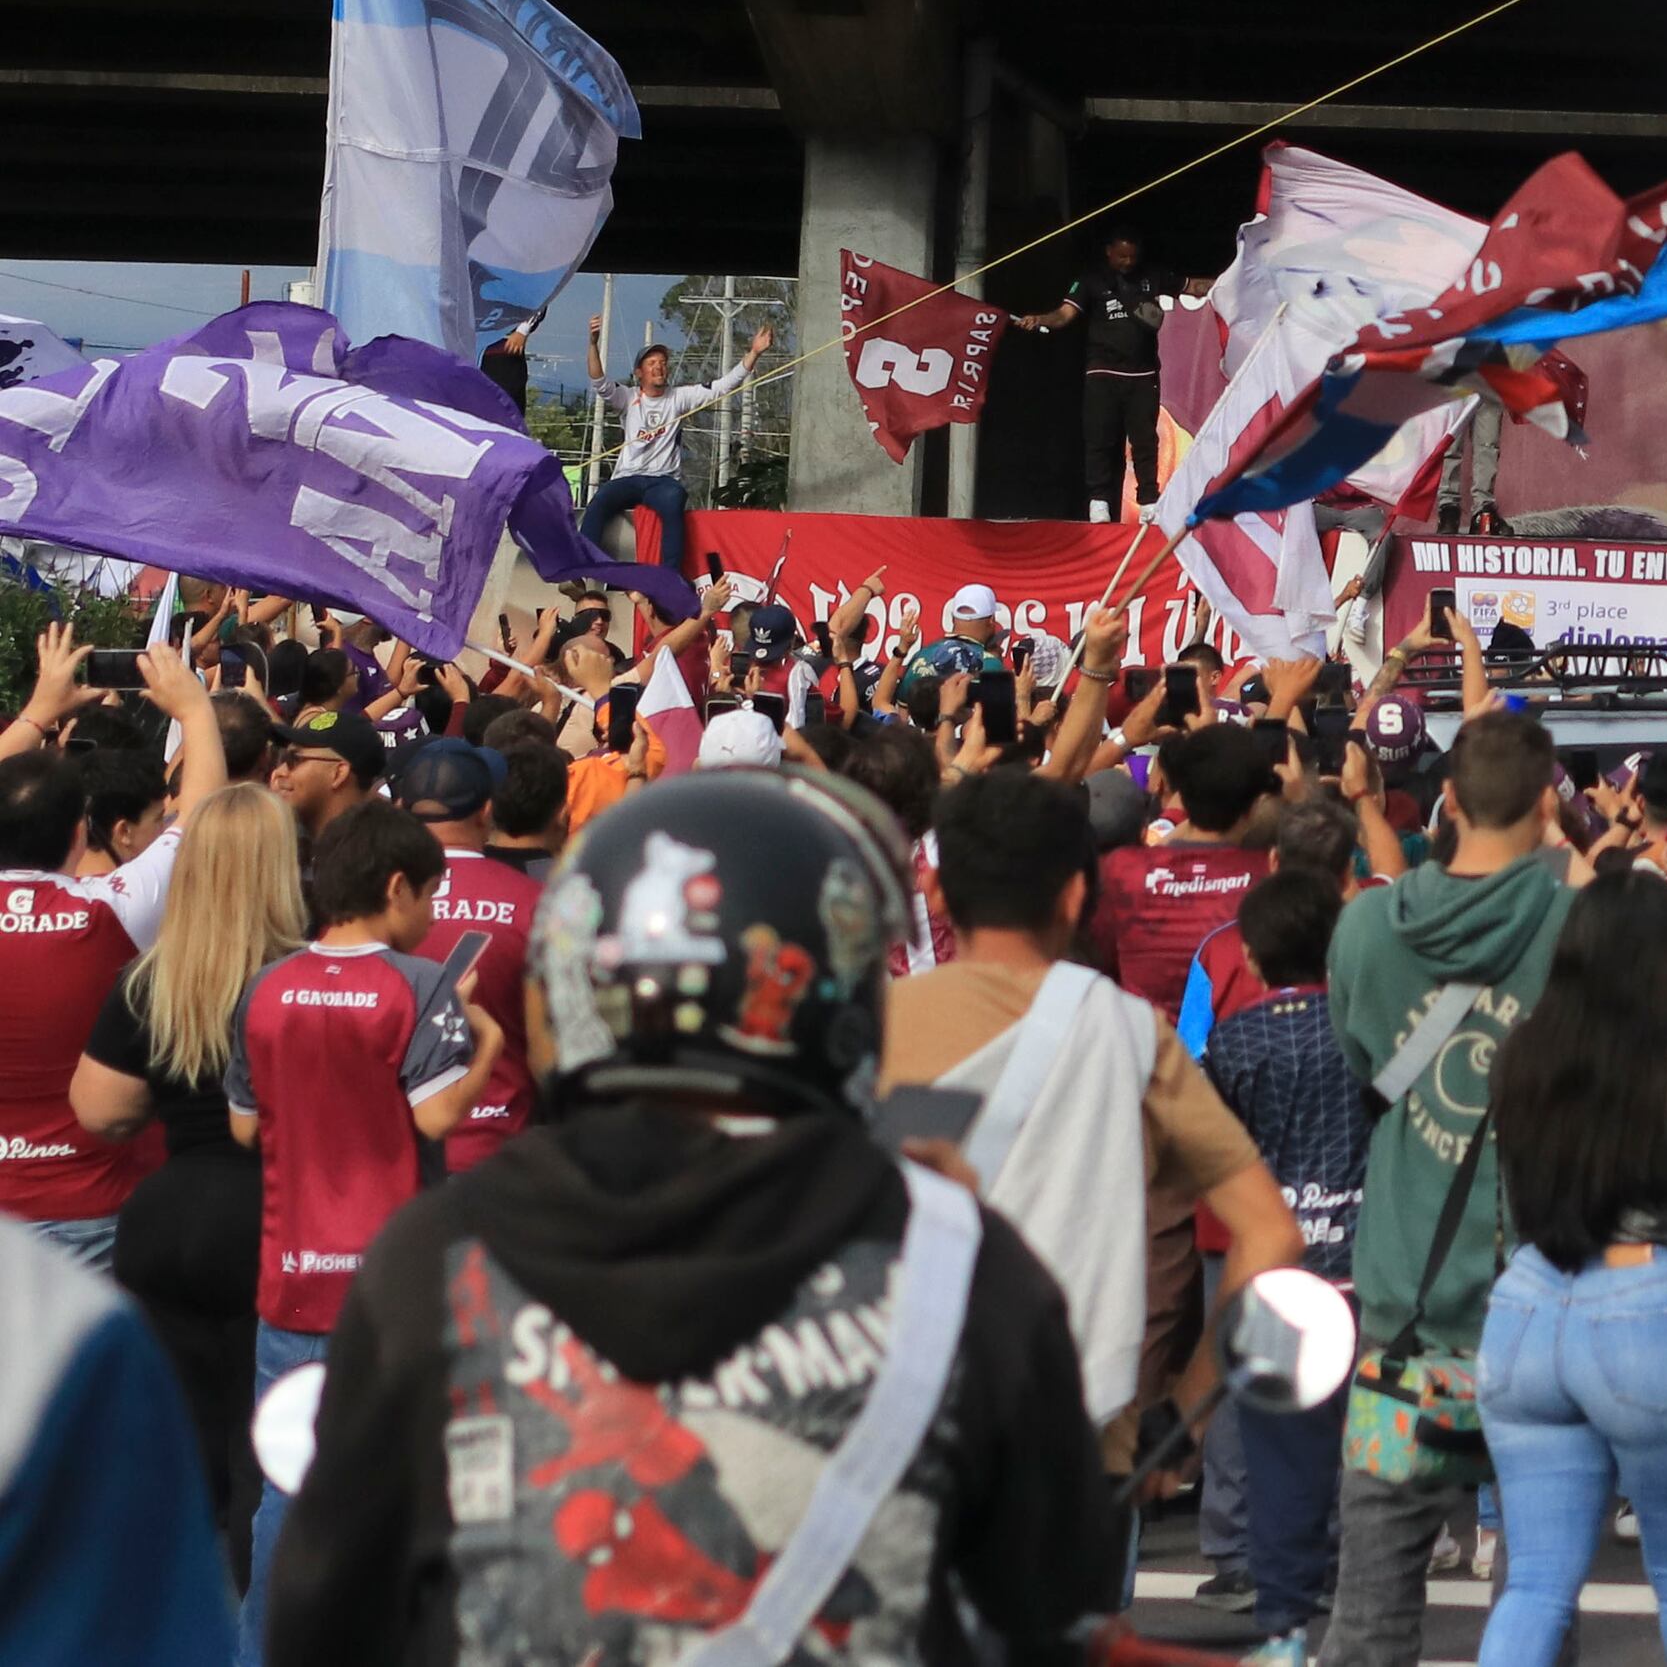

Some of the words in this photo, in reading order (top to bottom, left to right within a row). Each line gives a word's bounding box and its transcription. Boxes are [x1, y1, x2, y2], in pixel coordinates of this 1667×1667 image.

[1411, 541, 1451, 573] MI
[1456, 543, 1588, 578] HISTORIA.
[1594, 549, 1627, 579] TU
[1473, 607, 1498, 617] FIFA
[1577, 602, 1629, 621] place
[1378, 702, 1404, 735] S
[1162, 871, 1251, 898] medismart
[8, 889, 36, 912] G
[281, 990, 295, 1006] G
